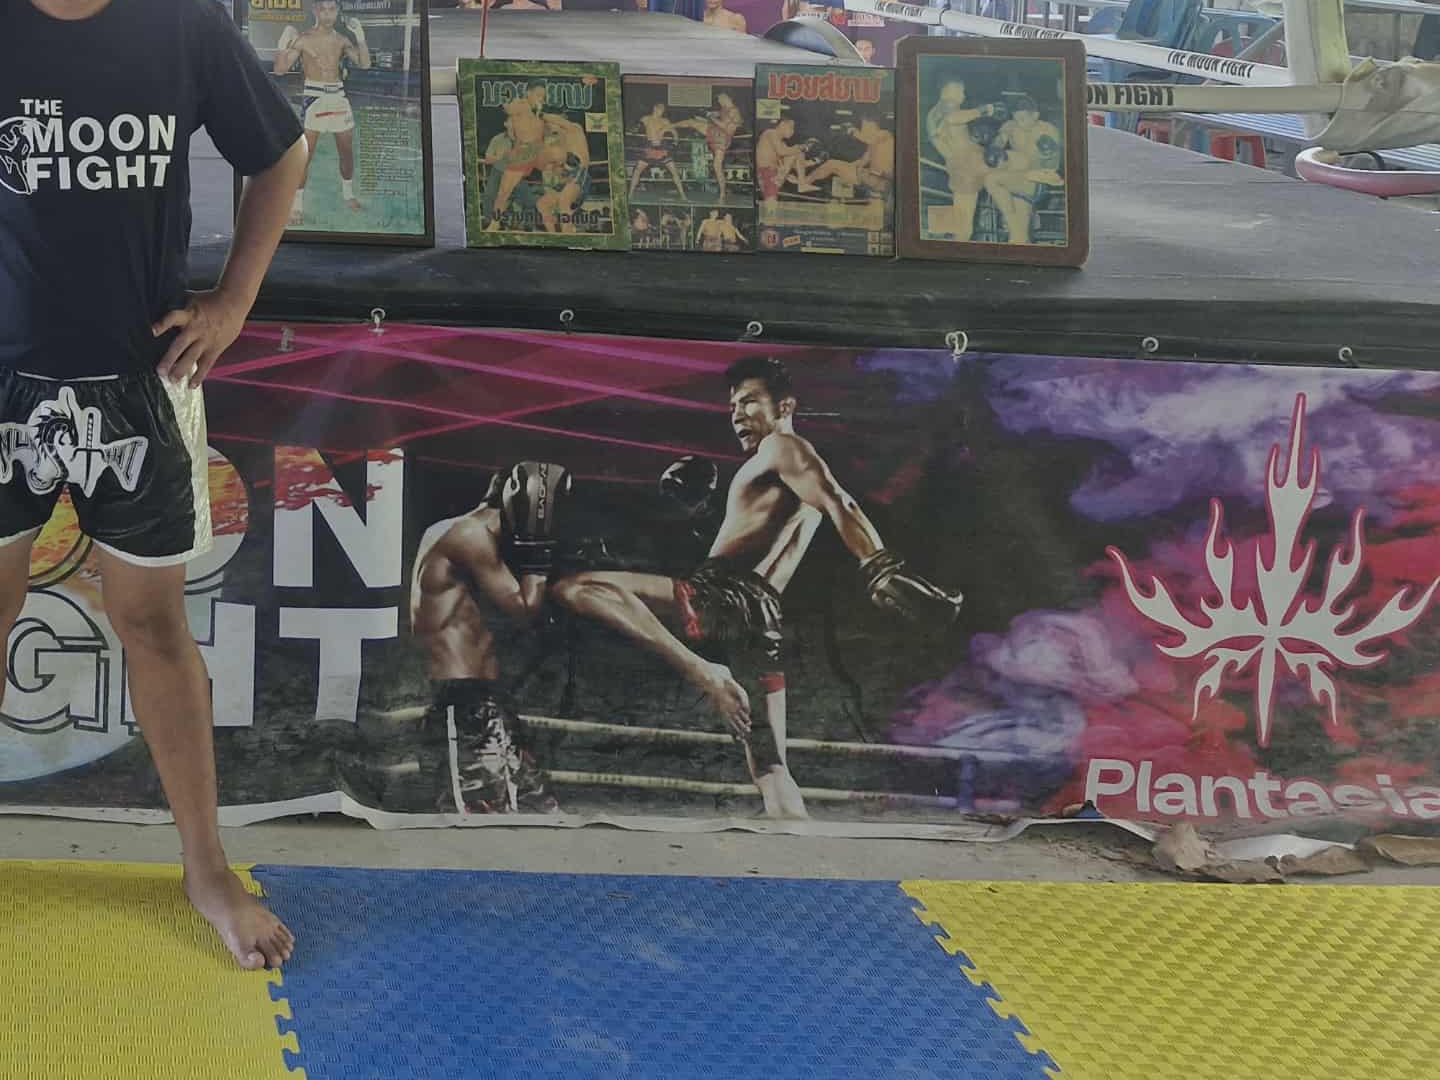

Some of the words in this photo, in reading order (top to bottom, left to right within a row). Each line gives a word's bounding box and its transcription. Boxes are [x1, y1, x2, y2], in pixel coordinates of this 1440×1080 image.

[1167, 50, 1186, 66] THE
[1186, 54, 1219, 73] MOON
[1220, 59, 1256, 79] FIGHT
[20, 98, 63, 116] THE
[1115, 86, 1175, 106] FIGHT
[22, 113, 176, 154] MOON
[24, 155, 172, 190] FIGHT
[1084, 757, 1440, 820] Plantasia
